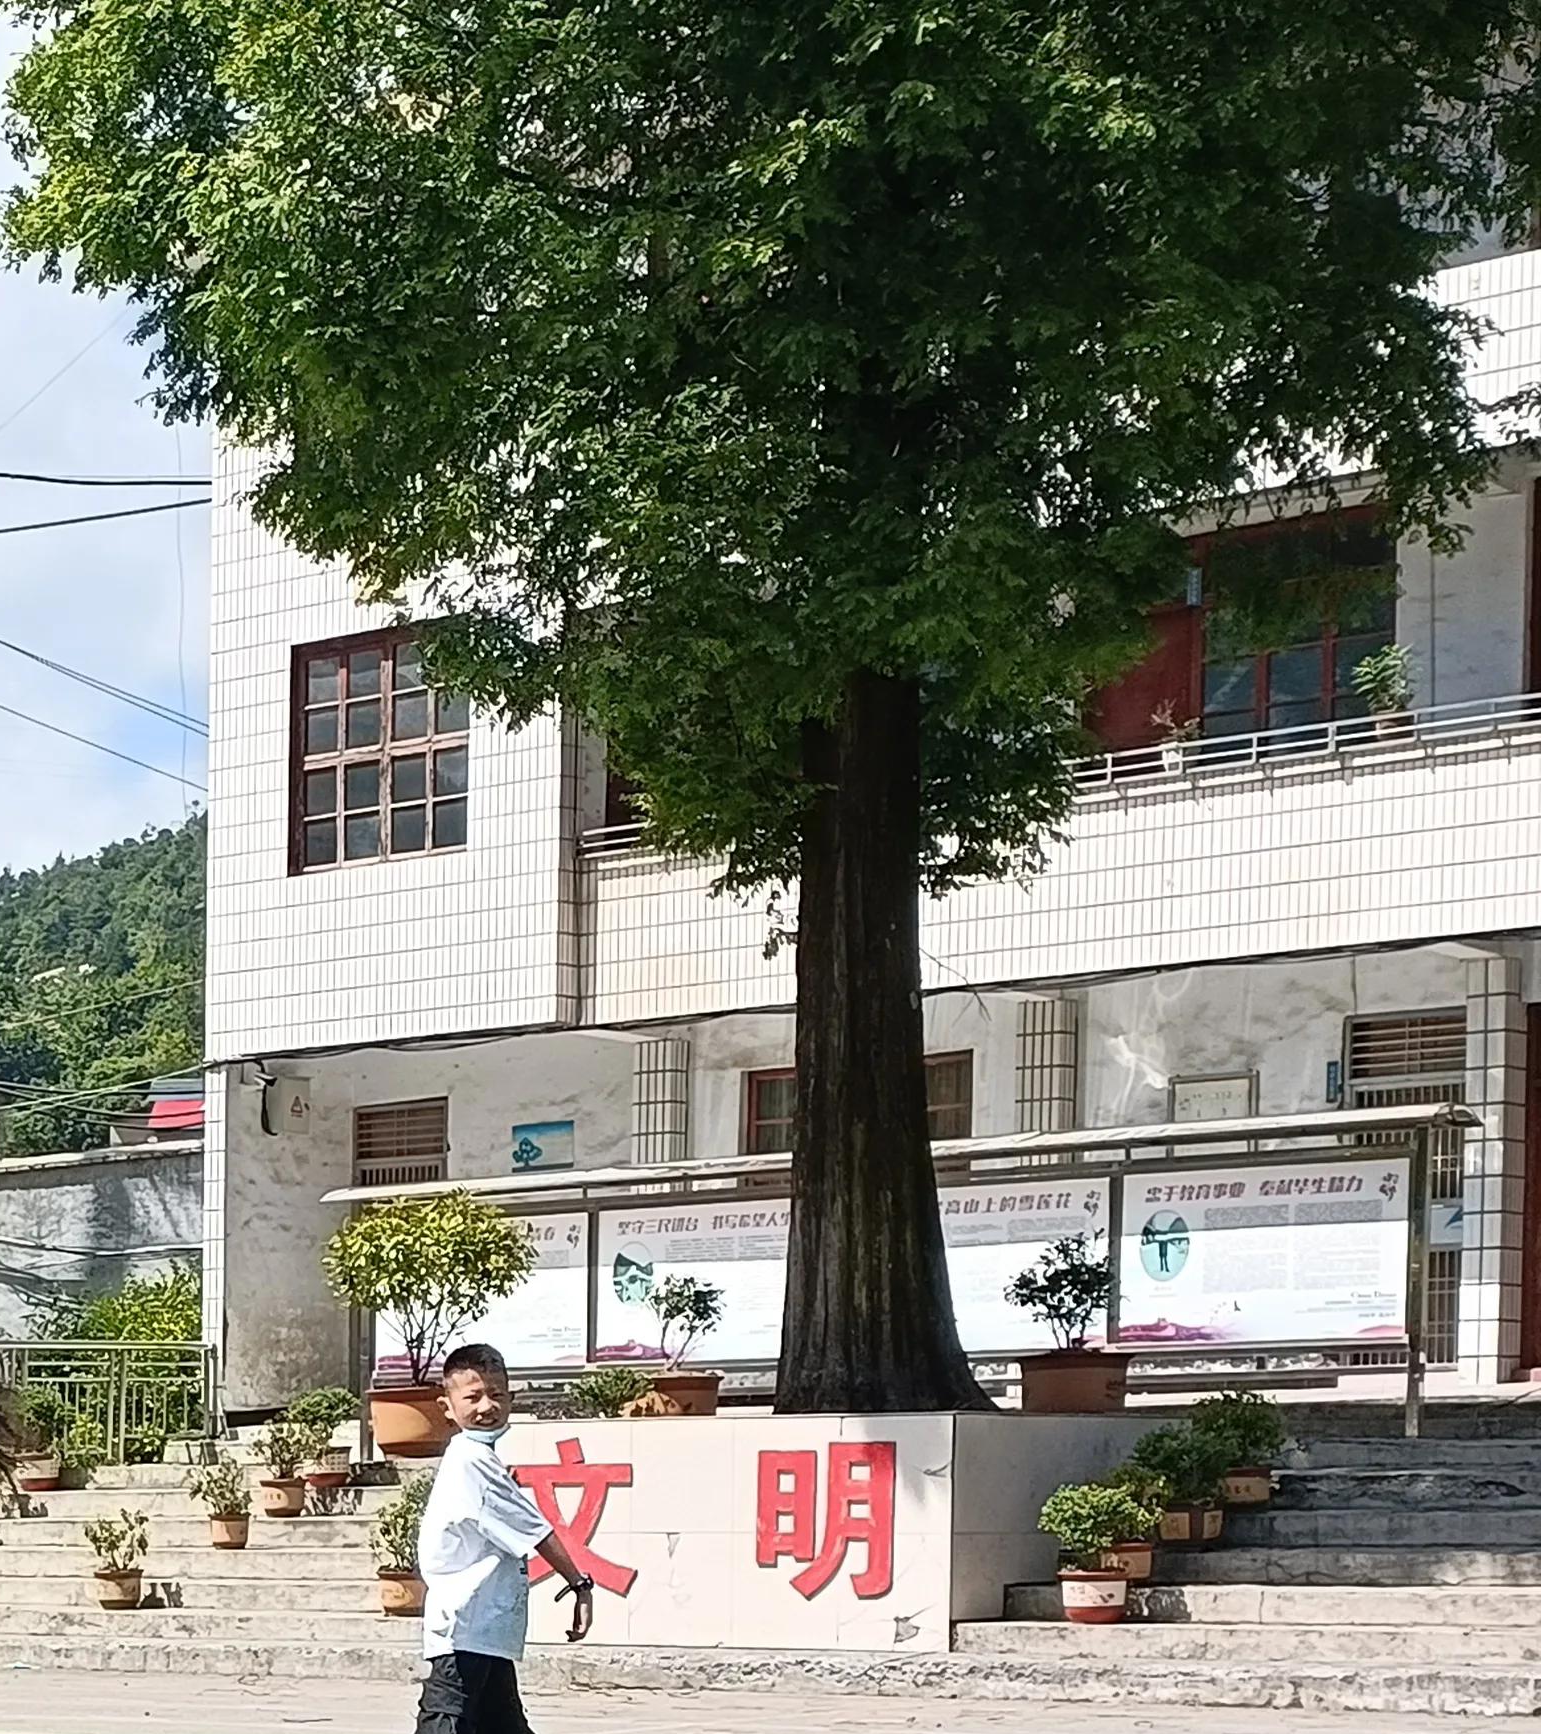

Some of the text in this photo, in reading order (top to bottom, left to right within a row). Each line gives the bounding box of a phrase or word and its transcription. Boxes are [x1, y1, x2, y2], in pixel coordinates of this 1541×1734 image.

[938, 1192, 1072, 1215] 高山上的雪莲花
[512, 1440, 896, 1600] 文明
